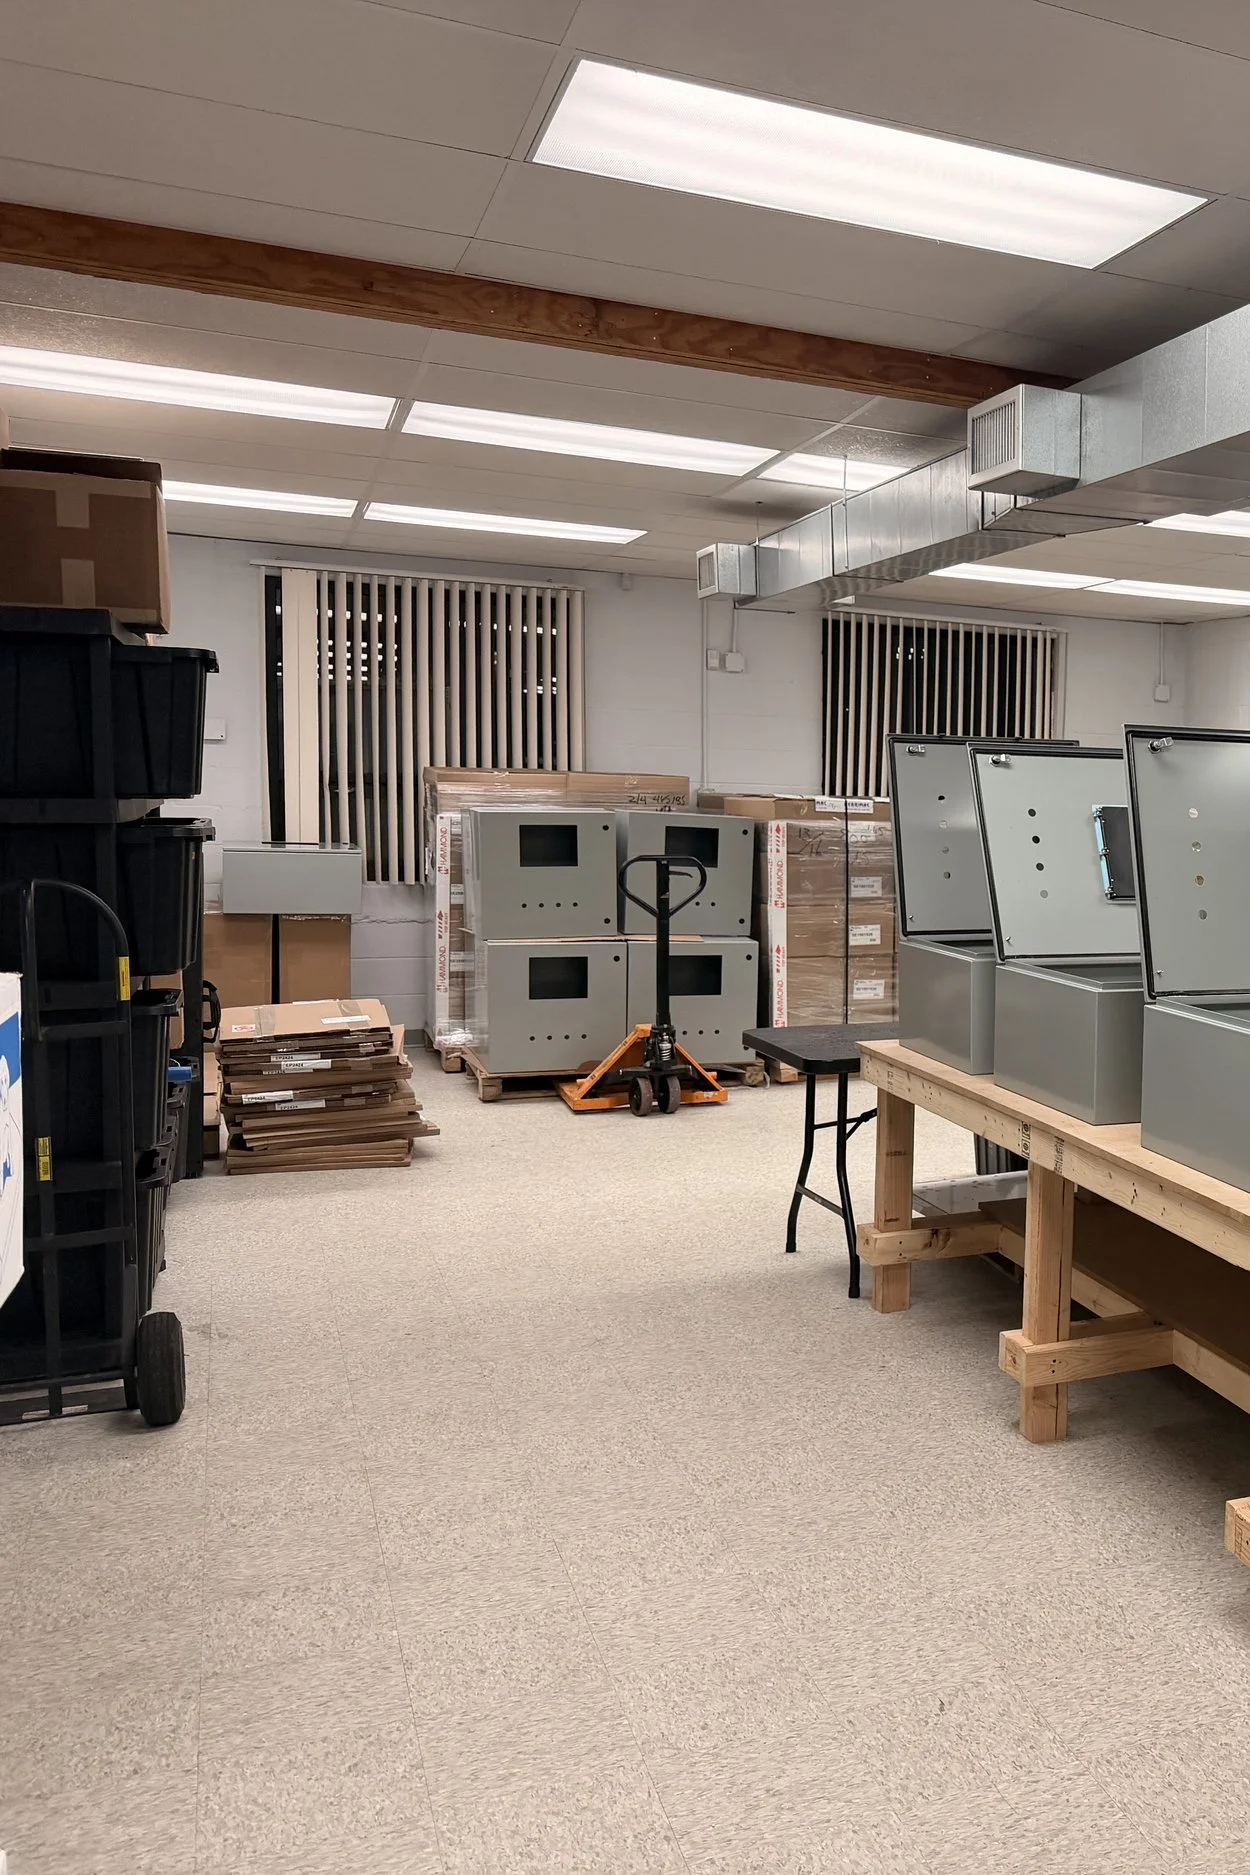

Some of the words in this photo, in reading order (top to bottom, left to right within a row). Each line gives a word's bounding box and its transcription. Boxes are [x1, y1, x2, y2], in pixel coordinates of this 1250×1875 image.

[439, 827, 447, 865] HAMMOND
[776, 860, 784, 899] HAMMOND
[776, 980, 784, 1019] HAMMOND
